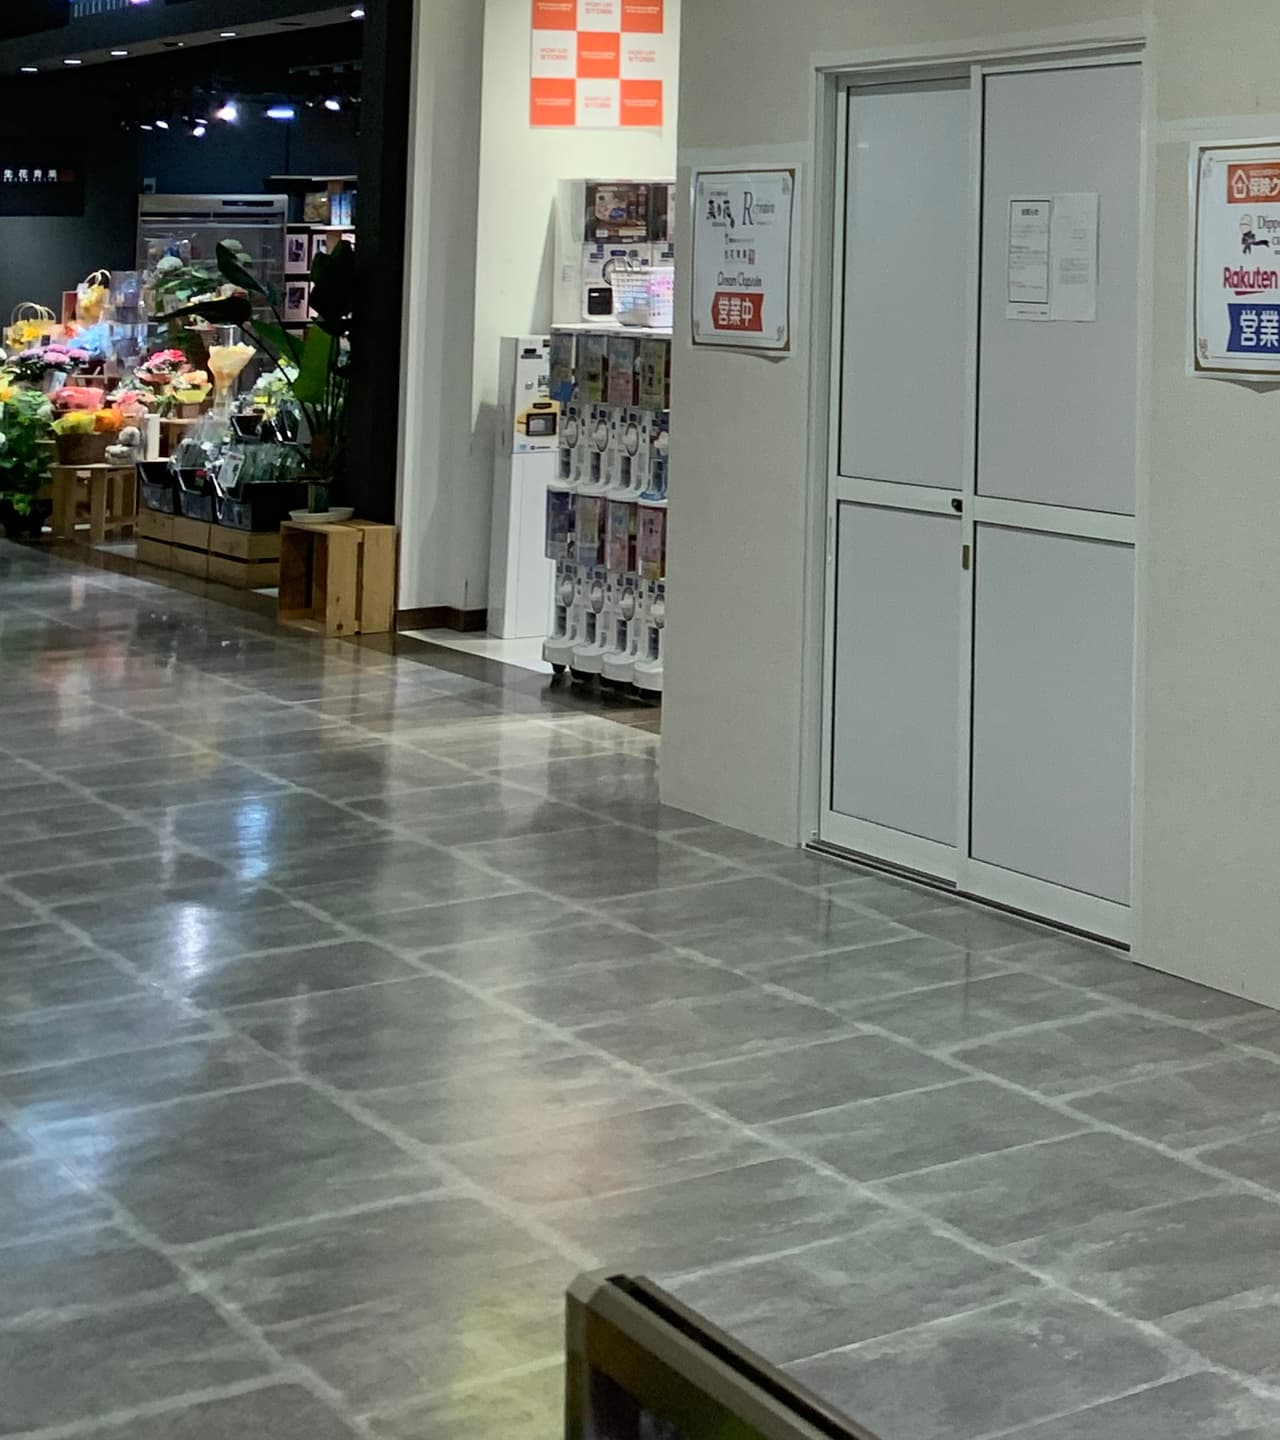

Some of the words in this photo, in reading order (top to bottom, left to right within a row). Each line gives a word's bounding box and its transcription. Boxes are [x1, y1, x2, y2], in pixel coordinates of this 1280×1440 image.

[1223, 266, 1278, 296] Rakuten
[718, 296, 753, 326] 営業中
